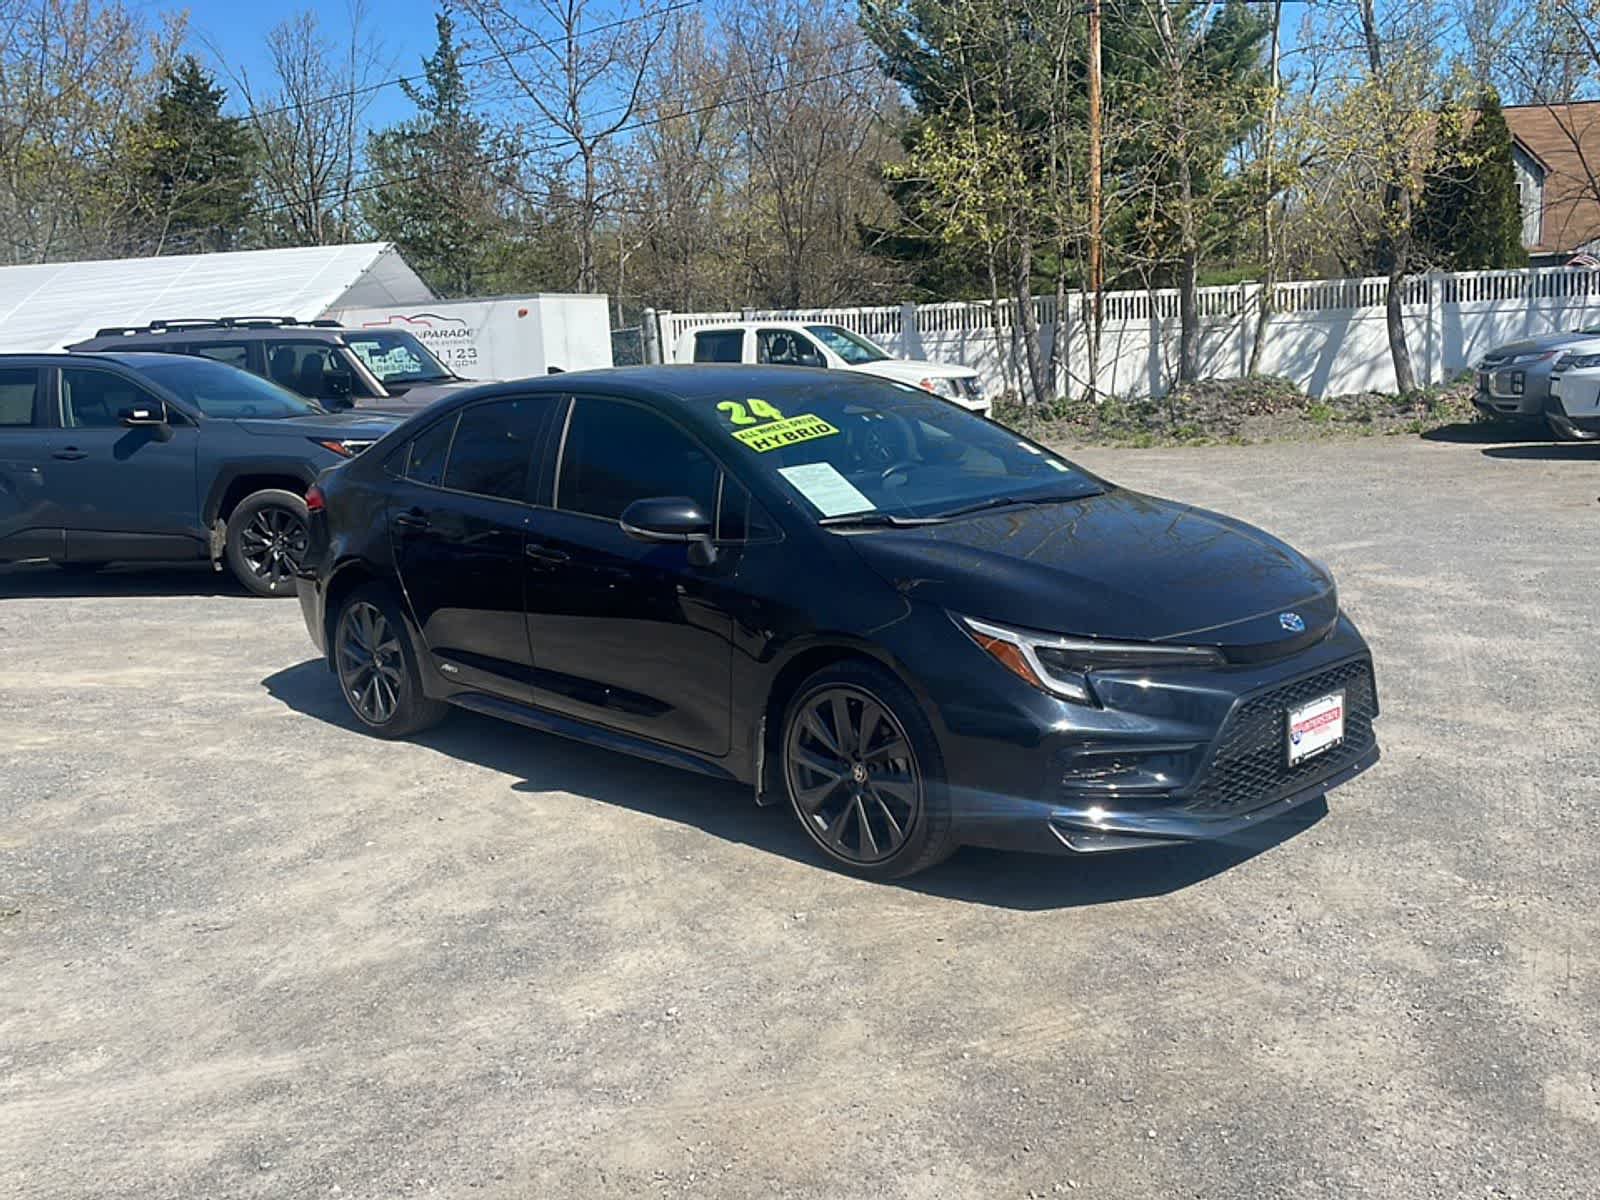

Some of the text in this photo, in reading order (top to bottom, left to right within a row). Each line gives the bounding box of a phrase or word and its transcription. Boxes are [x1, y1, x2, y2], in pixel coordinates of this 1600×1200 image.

[716, 398, 784, 425] 24
[739, 416, 819, 440] ALL WHEEL DRIVE
[752, 423, 831, 450] HYBRID
